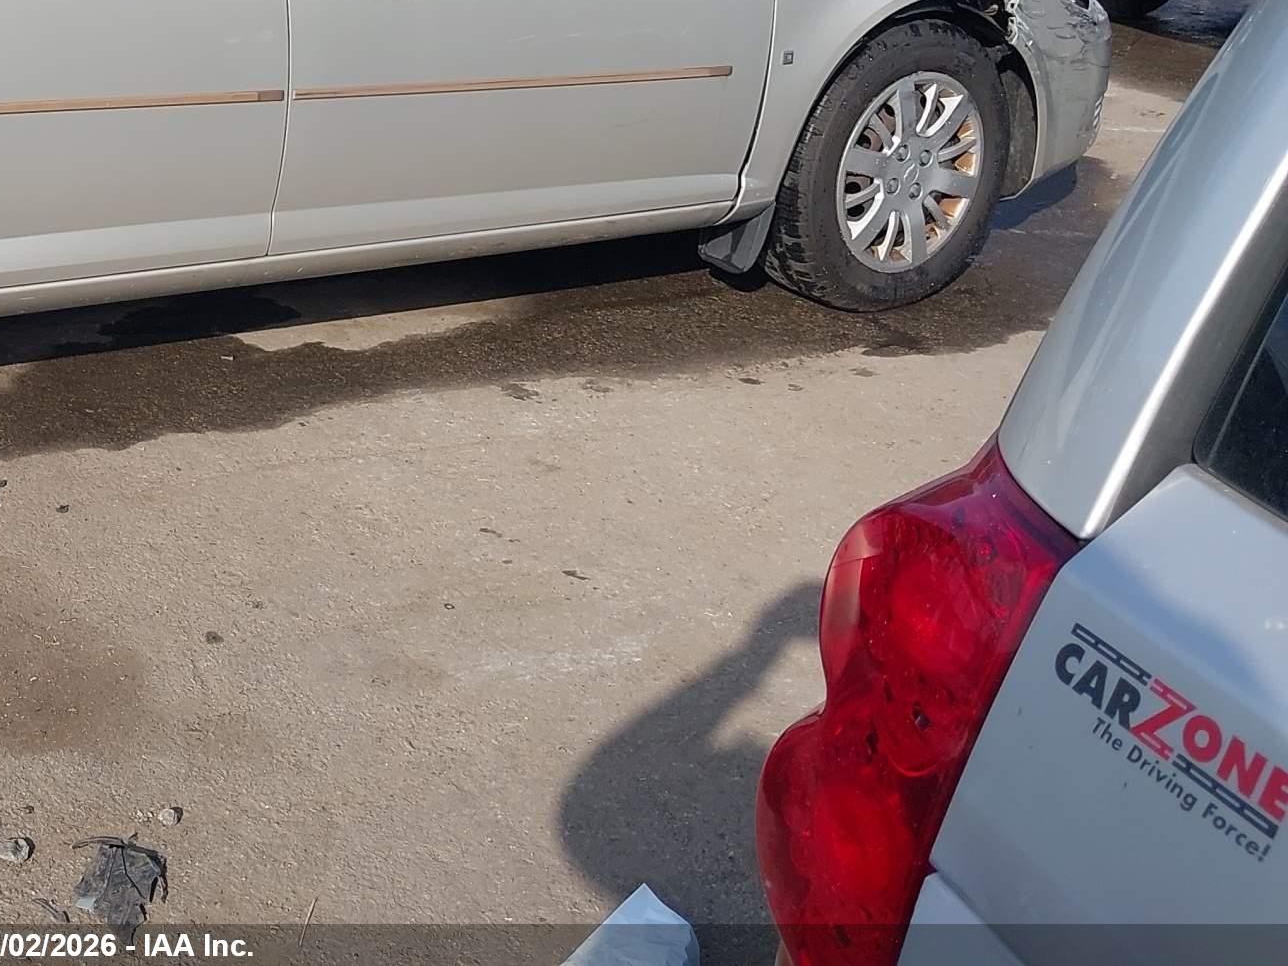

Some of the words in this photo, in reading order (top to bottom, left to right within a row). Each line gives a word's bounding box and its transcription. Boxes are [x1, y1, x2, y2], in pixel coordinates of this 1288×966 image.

[1091, 717, 1123, 752] The
[1126, 744, 1198, 812] Driving
[1202, 802, 1271, 863] Force!
